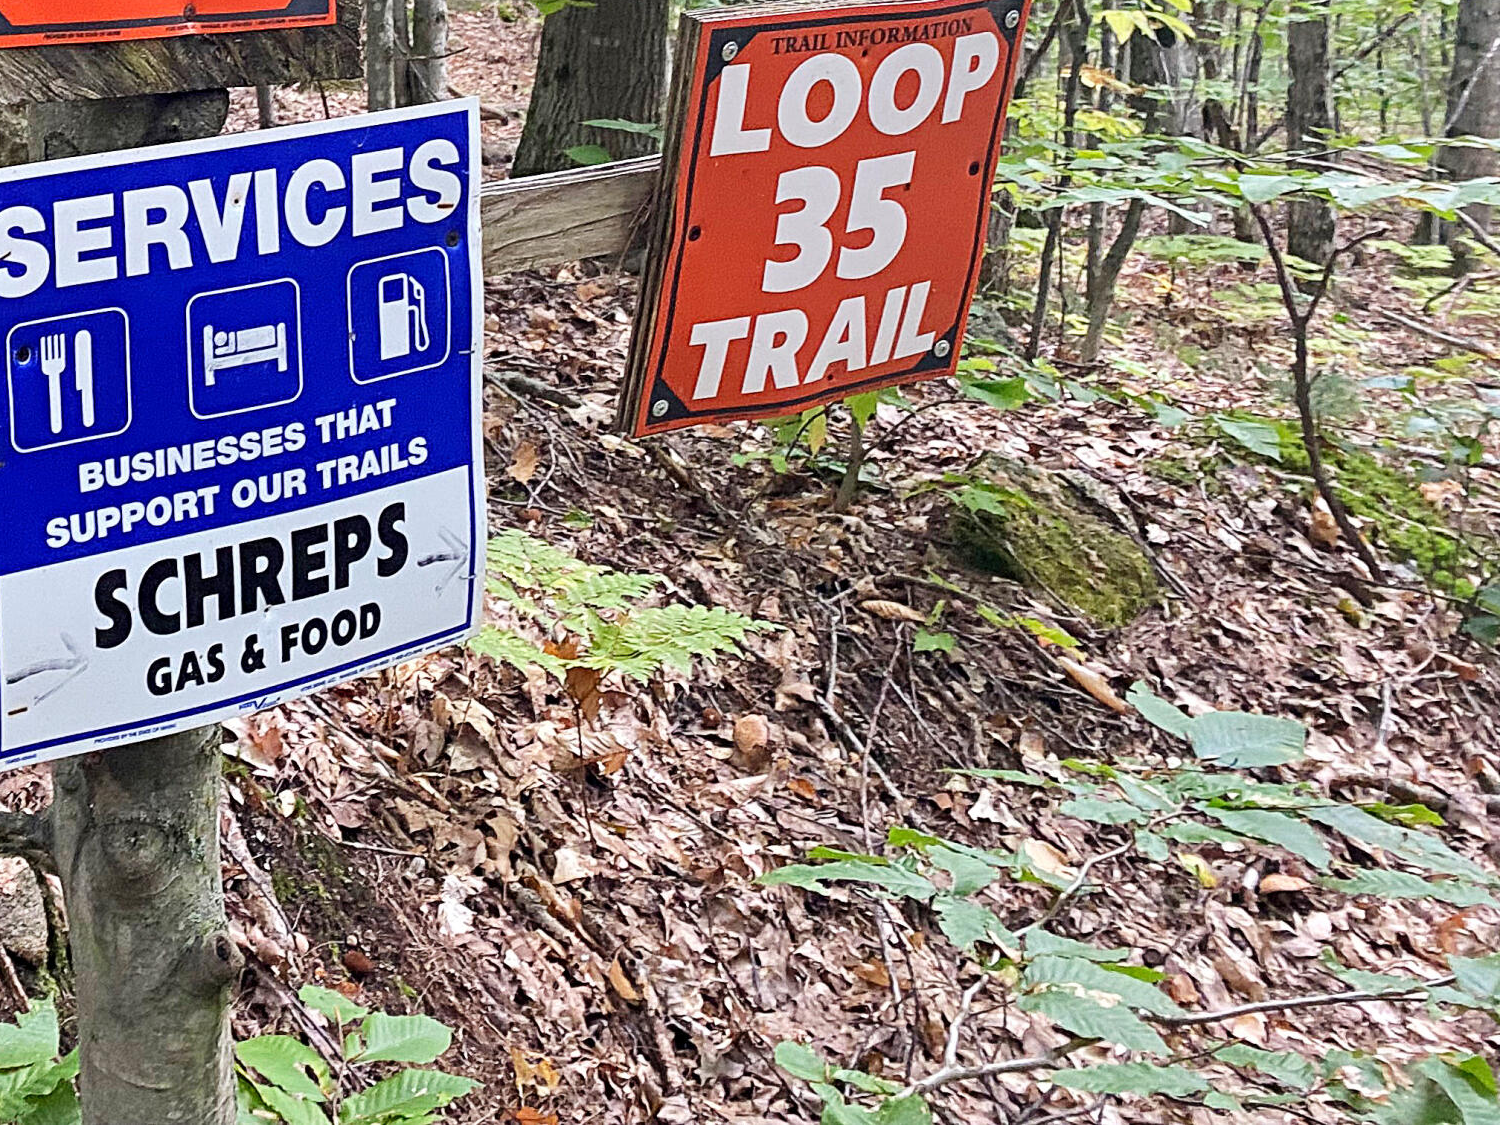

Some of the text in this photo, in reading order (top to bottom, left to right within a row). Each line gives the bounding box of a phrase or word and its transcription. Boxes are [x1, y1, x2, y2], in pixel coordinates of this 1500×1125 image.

[771, 17, 973, 55] TRAIL INFORMATION
[709, 31, 1000, 158] LOOP
[761, 150, 917, 293] 35
[689, 281, 936, 401] TRAIL
[45, 437, 429, 549] SUPPORT OUR TRAILS
[78, 399, 397, 493] BUSINESSES THAT
[93, 502, 410, 650] SCHREPS
[146, 644, 225, 697] GAS
[241, 634, 267, 675] &
[281, 602, 382, 663] FOOD
